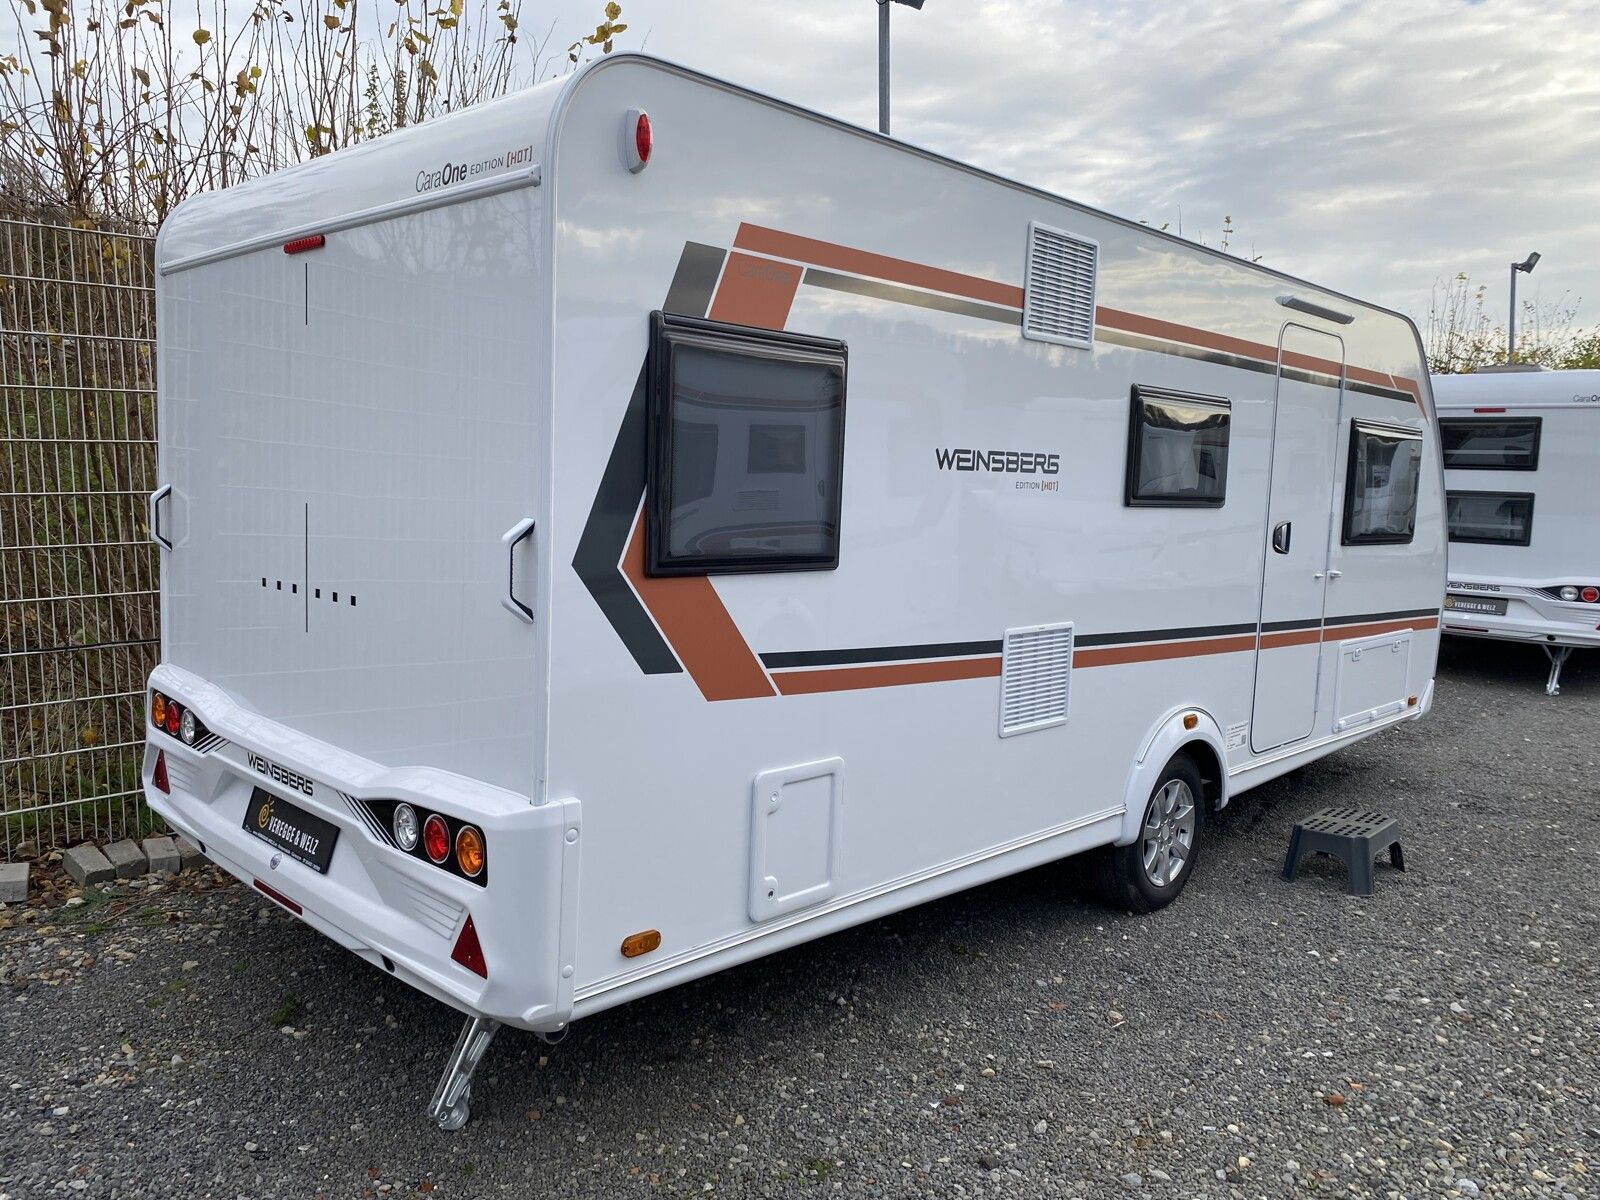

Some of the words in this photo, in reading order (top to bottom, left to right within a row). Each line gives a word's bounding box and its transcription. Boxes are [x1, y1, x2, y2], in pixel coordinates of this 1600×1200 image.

[416, 162, 467, 192] CaraOne
[470, 156, 504, 175] EDITION
[935, 447, 1060, 474] WEINSBERG
[1015, 481, 1040, 490] EDITION
[247, 752, 313, 796] WEINSBERG
[268, 815, 295, 843] VEREGGE
[294, 829, 301, 846] &
[299, 833, 319, 855] WELZ
